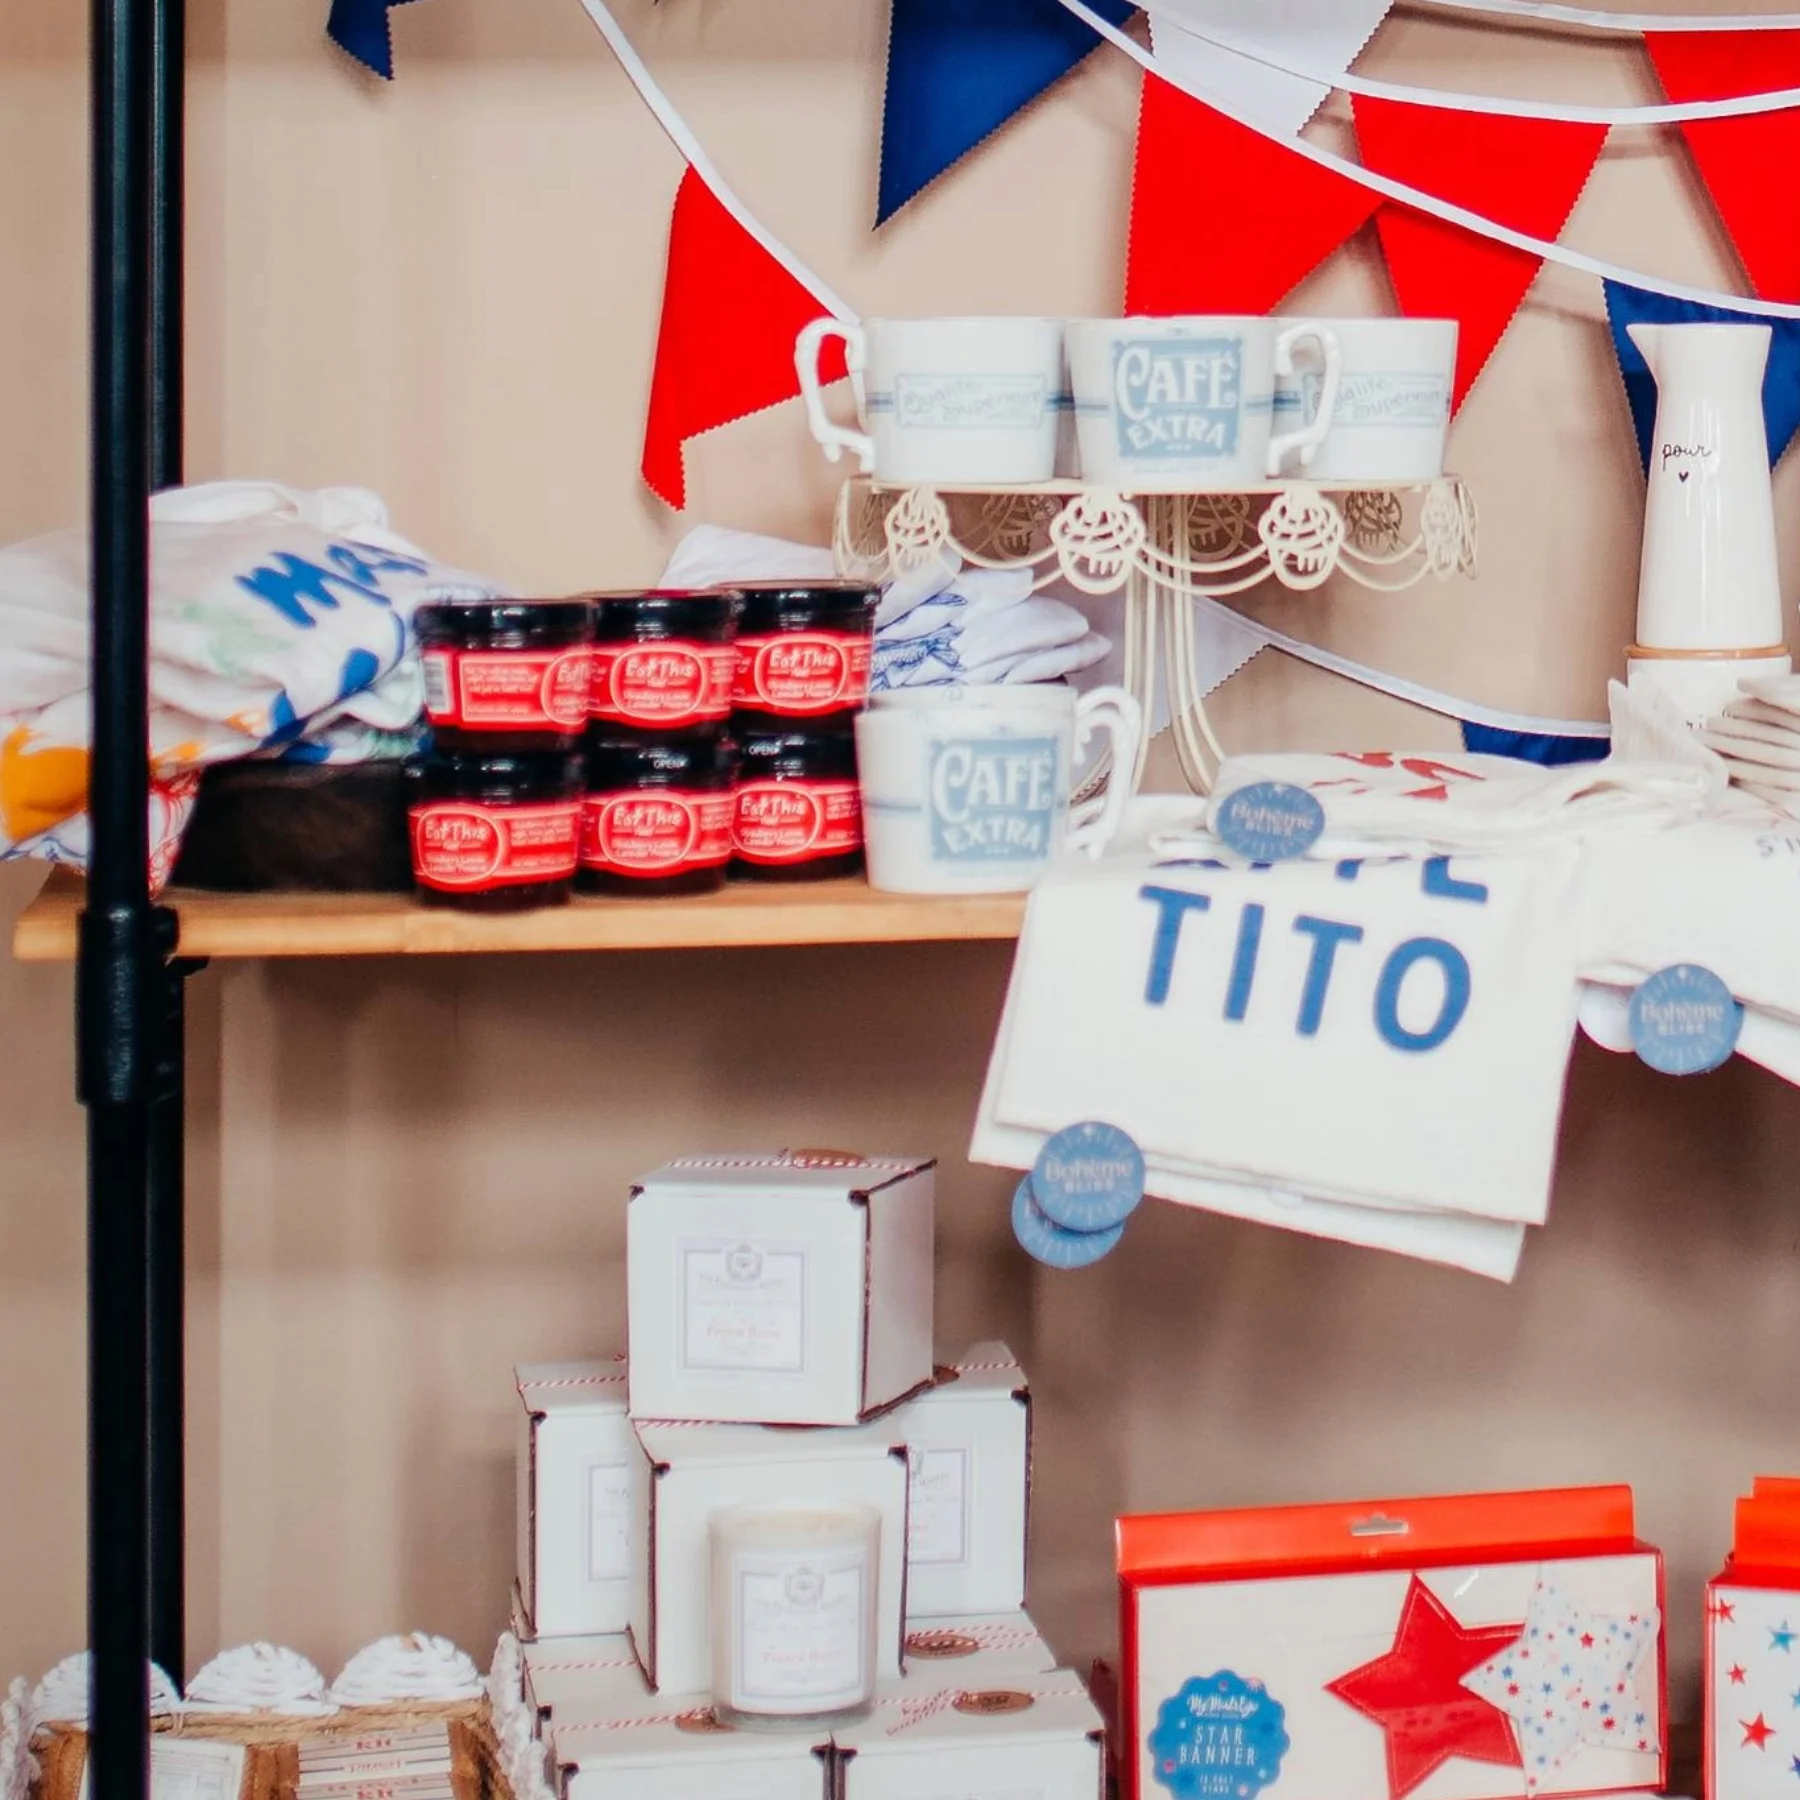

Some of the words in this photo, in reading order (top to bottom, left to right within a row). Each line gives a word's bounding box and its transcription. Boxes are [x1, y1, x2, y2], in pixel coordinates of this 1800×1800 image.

[1116, 347, 1239, 421] CAFÉ
[1126, 415, 1227, 450] EXTRA
[1662, 443, 1714, 471] pour
[626, 658, 658, 678] Eat
[659, 659, 695, 678] This
[770, 647, 801, 667] Eat
[803, 649, 837, 667] This
[613, 806, 645, 827] Eat
[645, 806, 682, 827] This
[741, 794, 772, 816] Eat
[772, 795, 807, 817] This
[424, 819, 452, 842] Eat
[452, 818, 487, 841] This
[942, 816, 1042, 855] EXTRA
[1138, 883, 1472, 1053] TITO
[1639, 1001, 1724, 1024] Bohème
[1044, 1157, 1134, 1182] Bohème
[1195, 1725, 1243, 1745] STAR
[1179, 1744, 1256, 1766] BANNER
